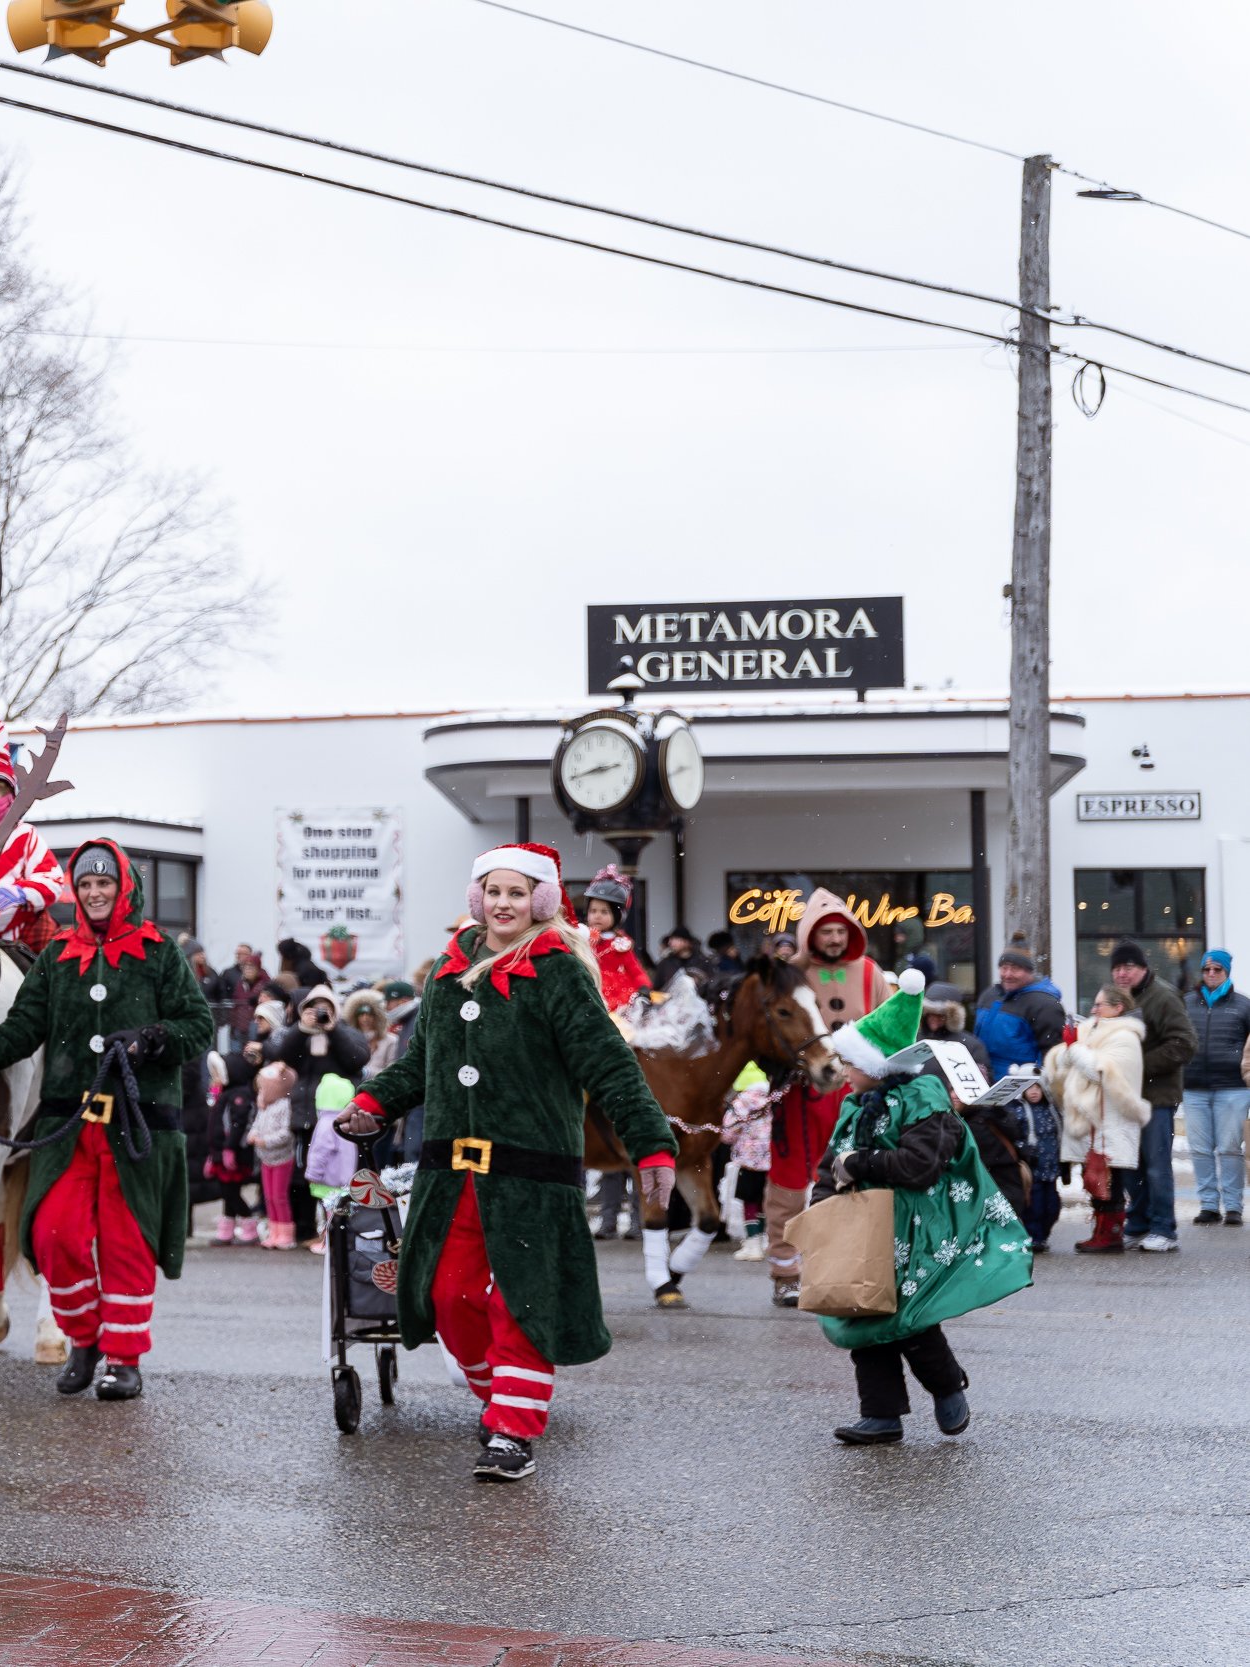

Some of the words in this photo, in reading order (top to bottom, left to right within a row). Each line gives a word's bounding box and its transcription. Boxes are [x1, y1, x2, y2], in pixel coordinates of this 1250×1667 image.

[612, 607, 879, 645] METAMORA
[637, 647, 854, 683] GENERAL
[1084, 797, 1196, 815] ESPRESSO
[303, 826, 333, 839] One
[337, 826, 372, 839] stop
[302, 846, 378, 860] shopping
[293, 867, 312, 879] for
[315, 867, 380, 880] everyone
[308, 888, 326, 899] on
[331, 888, 365, 900] your
[729, 888, 809, 934] Coffe
[924, 892, 976, 928] Ba
